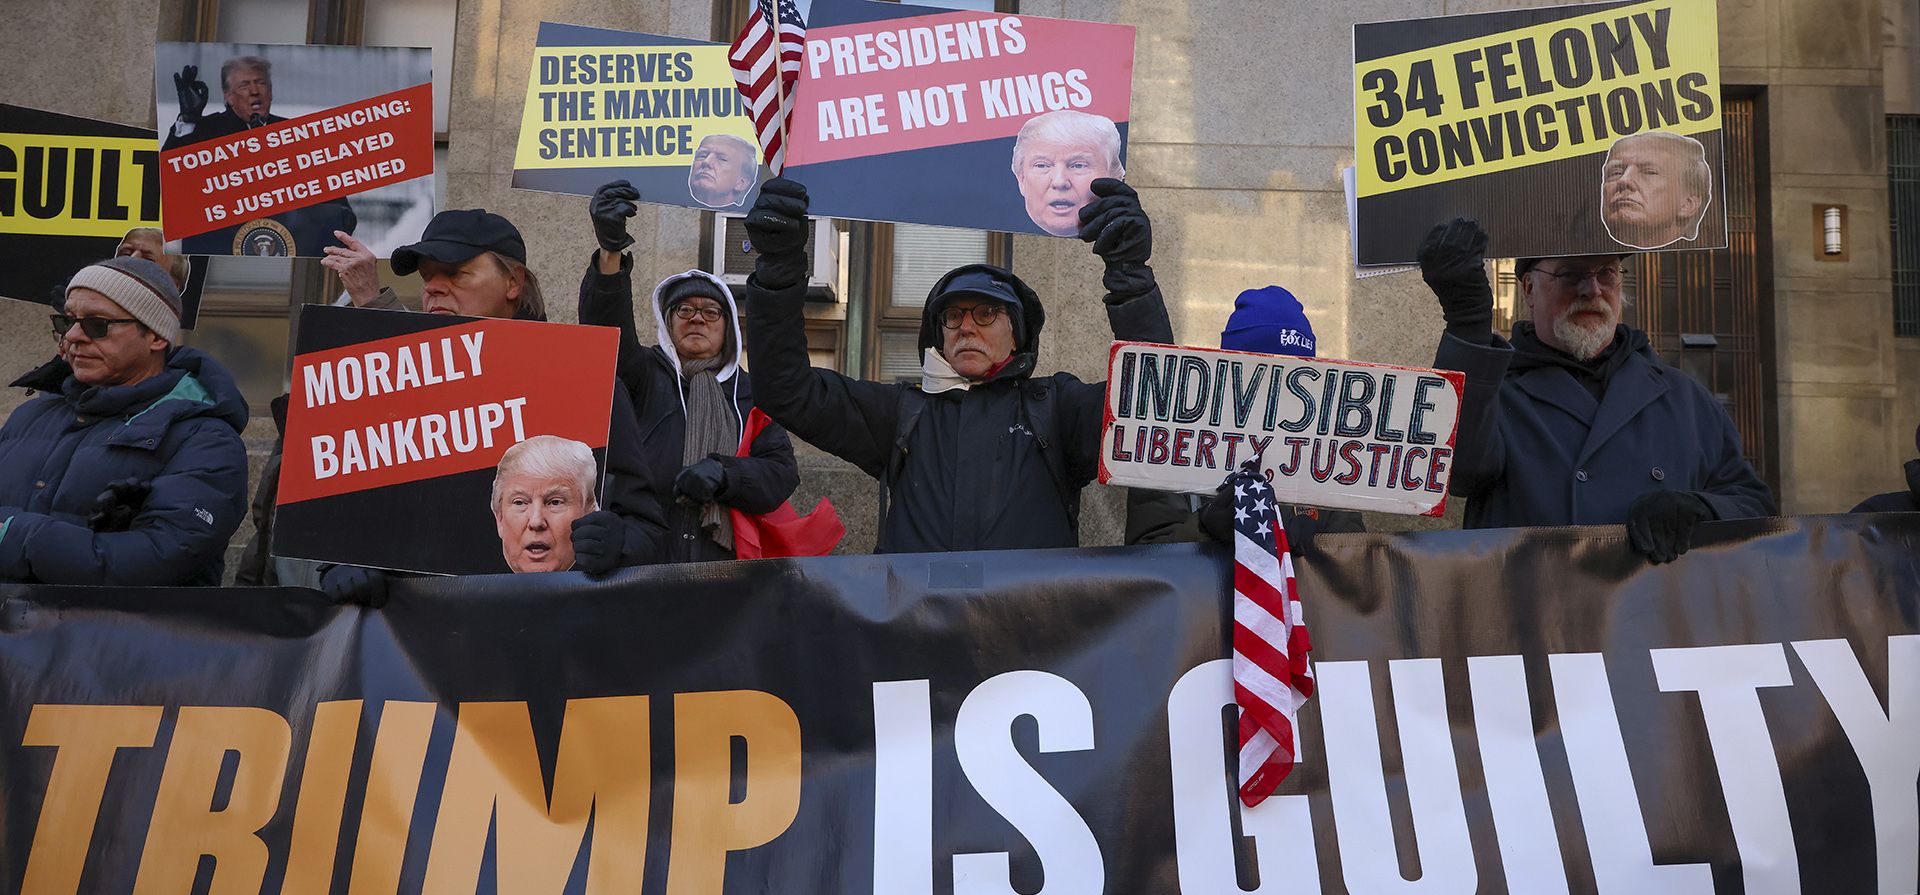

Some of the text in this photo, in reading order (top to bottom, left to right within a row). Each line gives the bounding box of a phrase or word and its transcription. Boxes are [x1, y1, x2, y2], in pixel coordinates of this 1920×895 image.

[540, 52, 693, 85] DESERVES
[806, 16, 1027, 79] PRESIDENTS
[1362, 7, 1672, 128] 34 FELONY
[168, 99, 412, 173] TODAY'S SENTENCING:
[539, 91, 595, 122] THE
[817, 68, 1092, 142] ARE NOT KINGS
[1373, 72, 1714, 183] CONVICTIONS
[201, 131, 395, 195] JUSTICE DELAYED
[539, 125, 693, 160] SENTENCE
[204, 158, 406, 222] IS JUSTICE DENIED
[303, 331, 485, 409] MORALLY
[1280, 334, 1301, 347] FOX
[1118, 352, 1446, 445] INDIVISIBLE
[311, 397, 527, 480] BANKRUPT
[1279, 437, 1452, 494] JUSTICE
[20, 635, 1920, 895] TRUMP IS GUILTY
